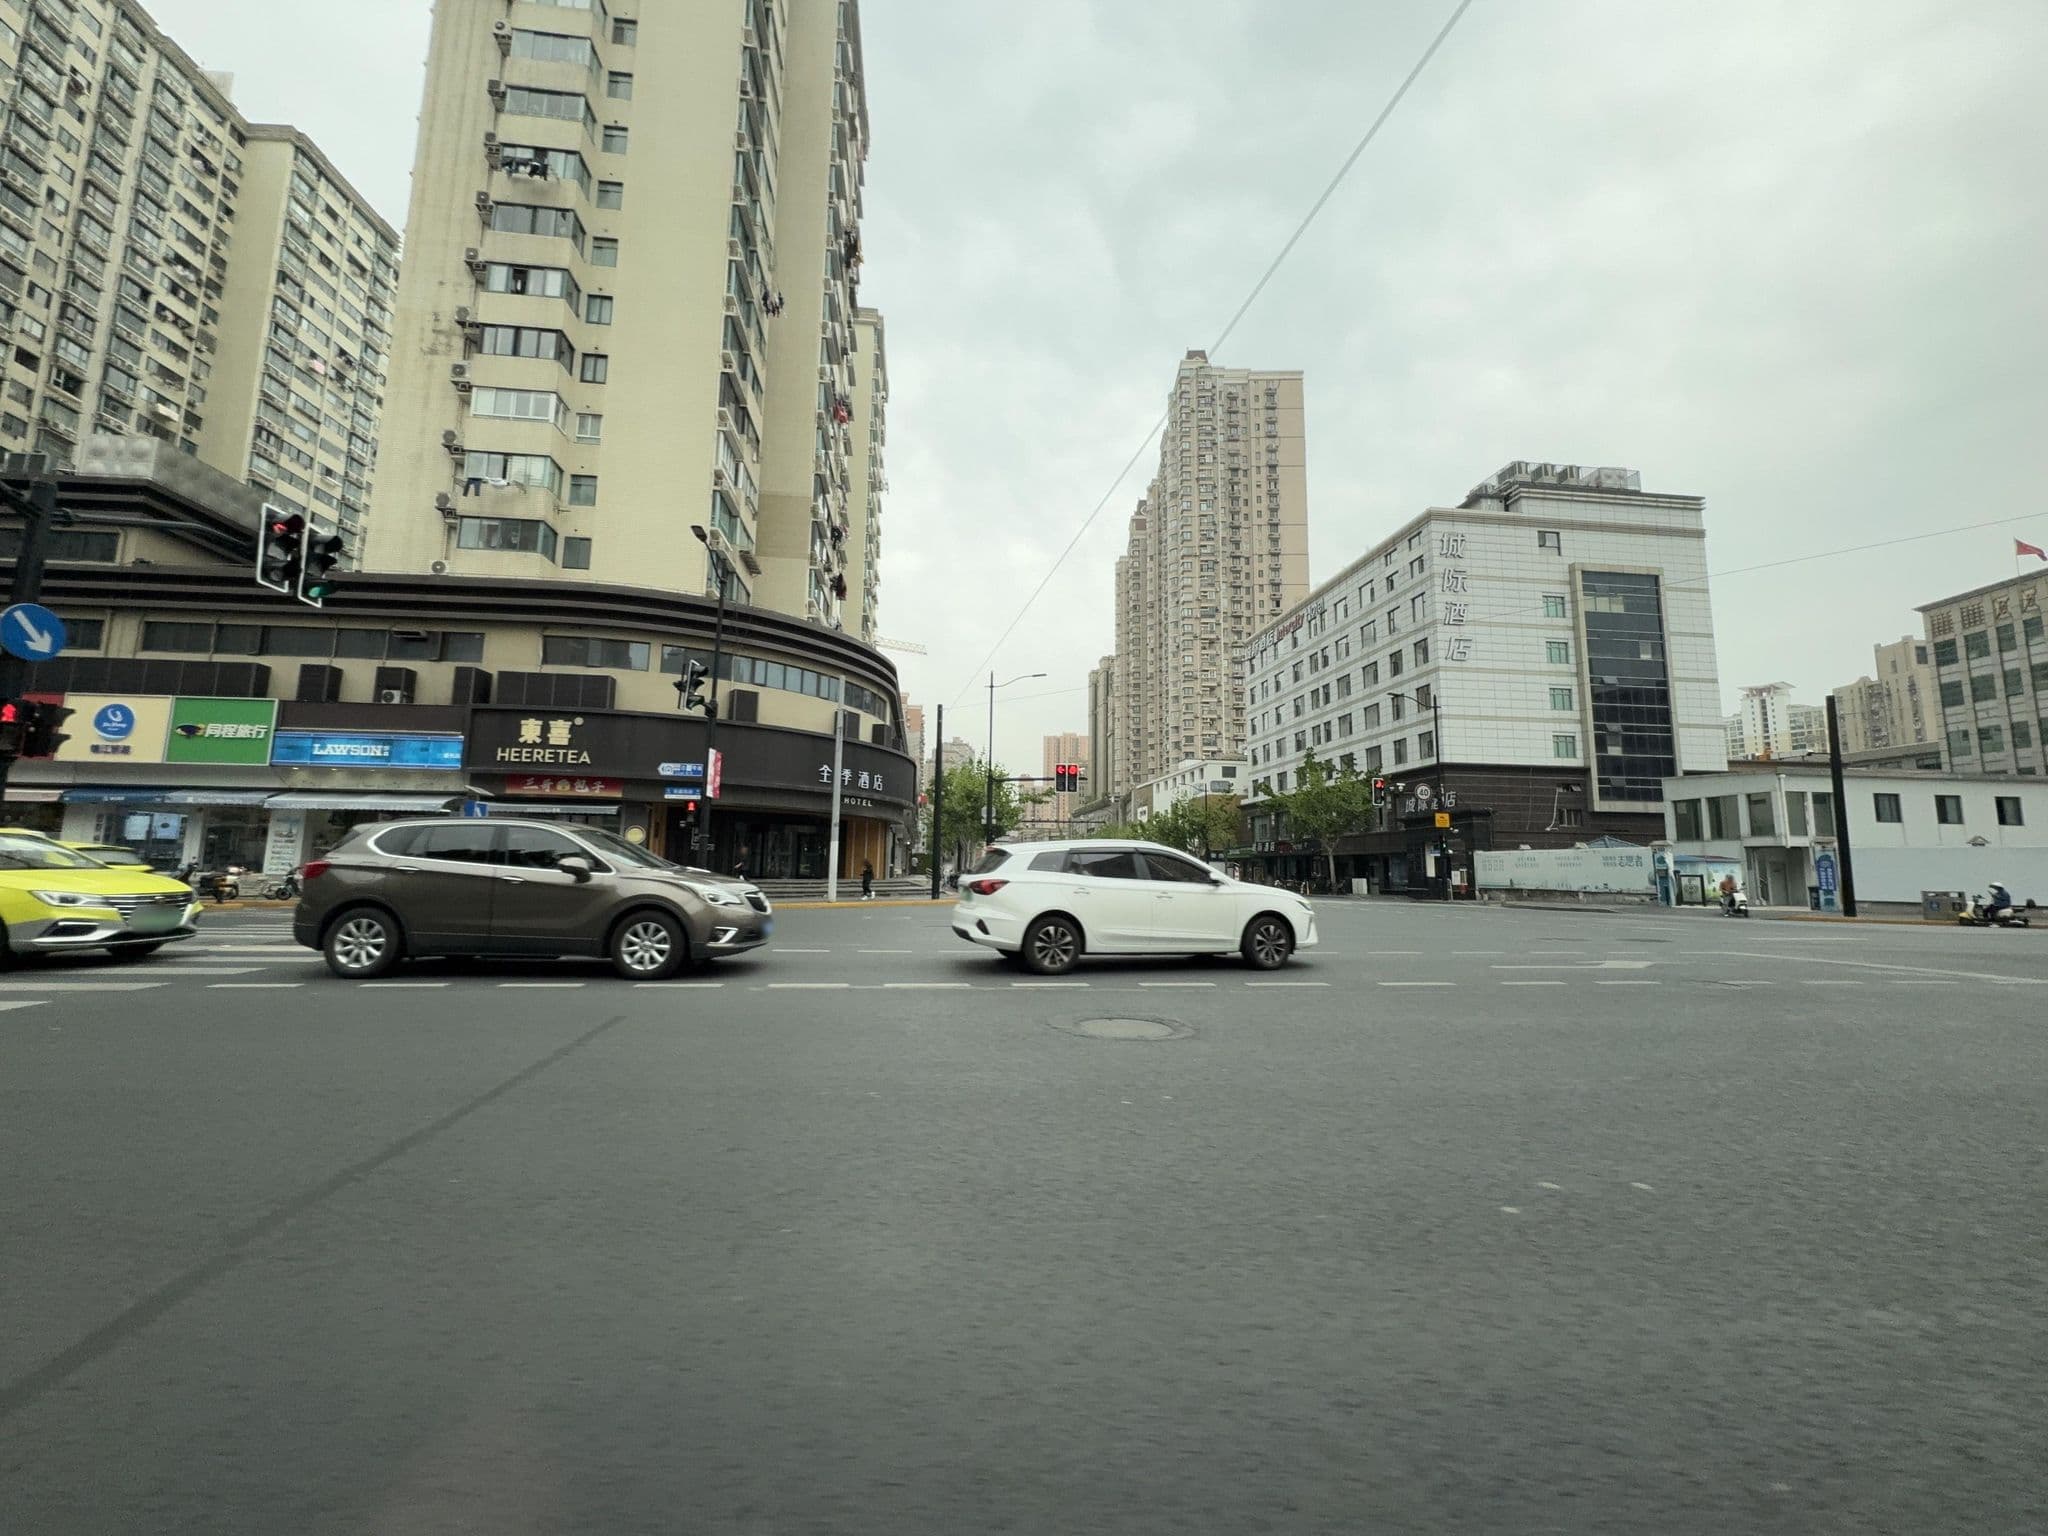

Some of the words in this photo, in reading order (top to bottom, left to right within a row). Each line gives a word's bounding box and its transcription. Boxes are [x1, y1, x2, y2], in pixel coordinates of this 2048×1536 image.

[1440, 532, 1472, 661] 城际酒店
[204, 723, 269, 739] 同程旅行
[518, 718, 572, 746] 東喜
[312, 743, 382, 757] LAWSON
[496, 747, 591, 764] HEERETEA
[818, 764, 883, 791] 全季酒店
[1420, 788, 1429, 797] 40
[844, 797, 872, 807] HOTEL
